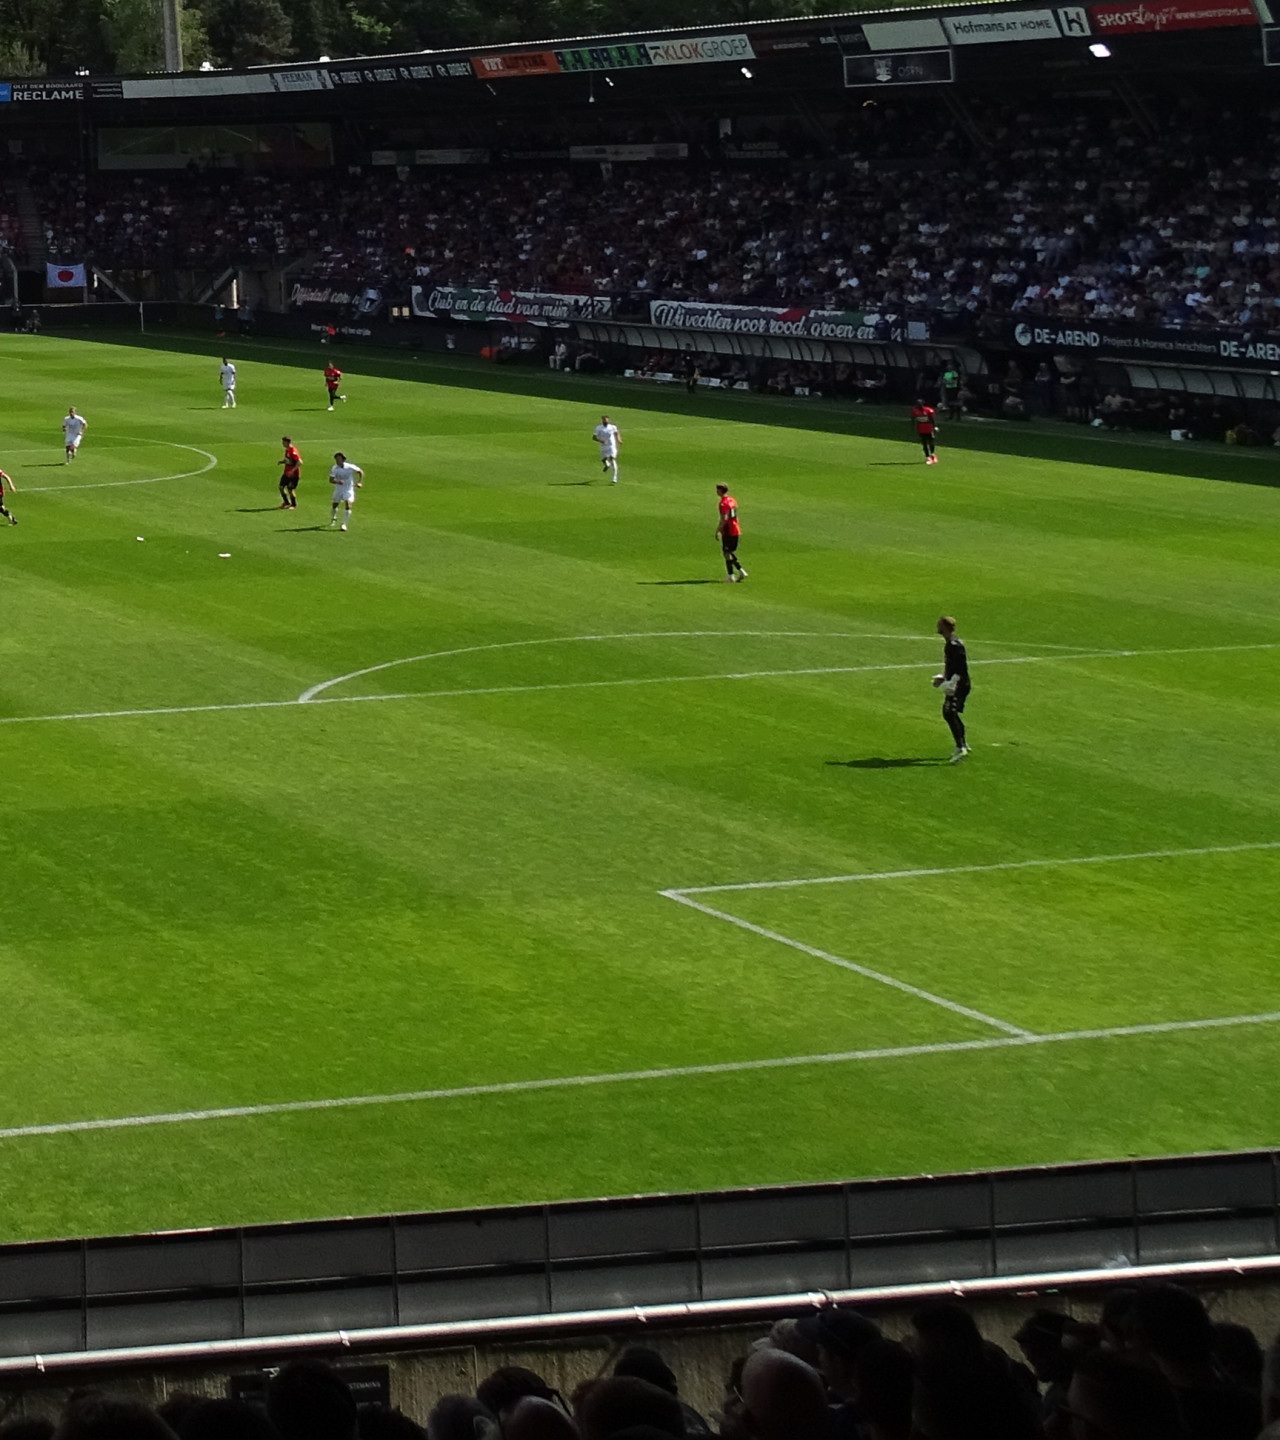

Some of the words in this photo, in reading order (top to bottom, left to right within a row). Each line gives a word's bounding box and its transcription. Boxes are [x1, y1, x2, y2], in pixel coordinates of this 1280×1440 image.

[953, 20, 1004, 35] Hofmans
[1021, 18, 1052, 30] HOME
[662, 38, 748, 60] KLOKGROEP
[13, 89, 84, 101] RECLAME
[427, 290, 453, 311] Club
[455, 299, 468, 310] en
[469, 298, 484, 311] de
[486, 296, 514, 314] stad
[516, 302, 540, 316] van
[685, 312, 732, 330] vechten
[732, 318, 766, 335] voor
[810, 322, 855, 338] groen
[856, 326, 874, 340] en
[1034, 328, 1100, 348] DE-AREND
[1102, 335, 1131, 347] Project
[1132, 338, 1141, 347] &
[1142, 338, 1173, 350] Horeca
